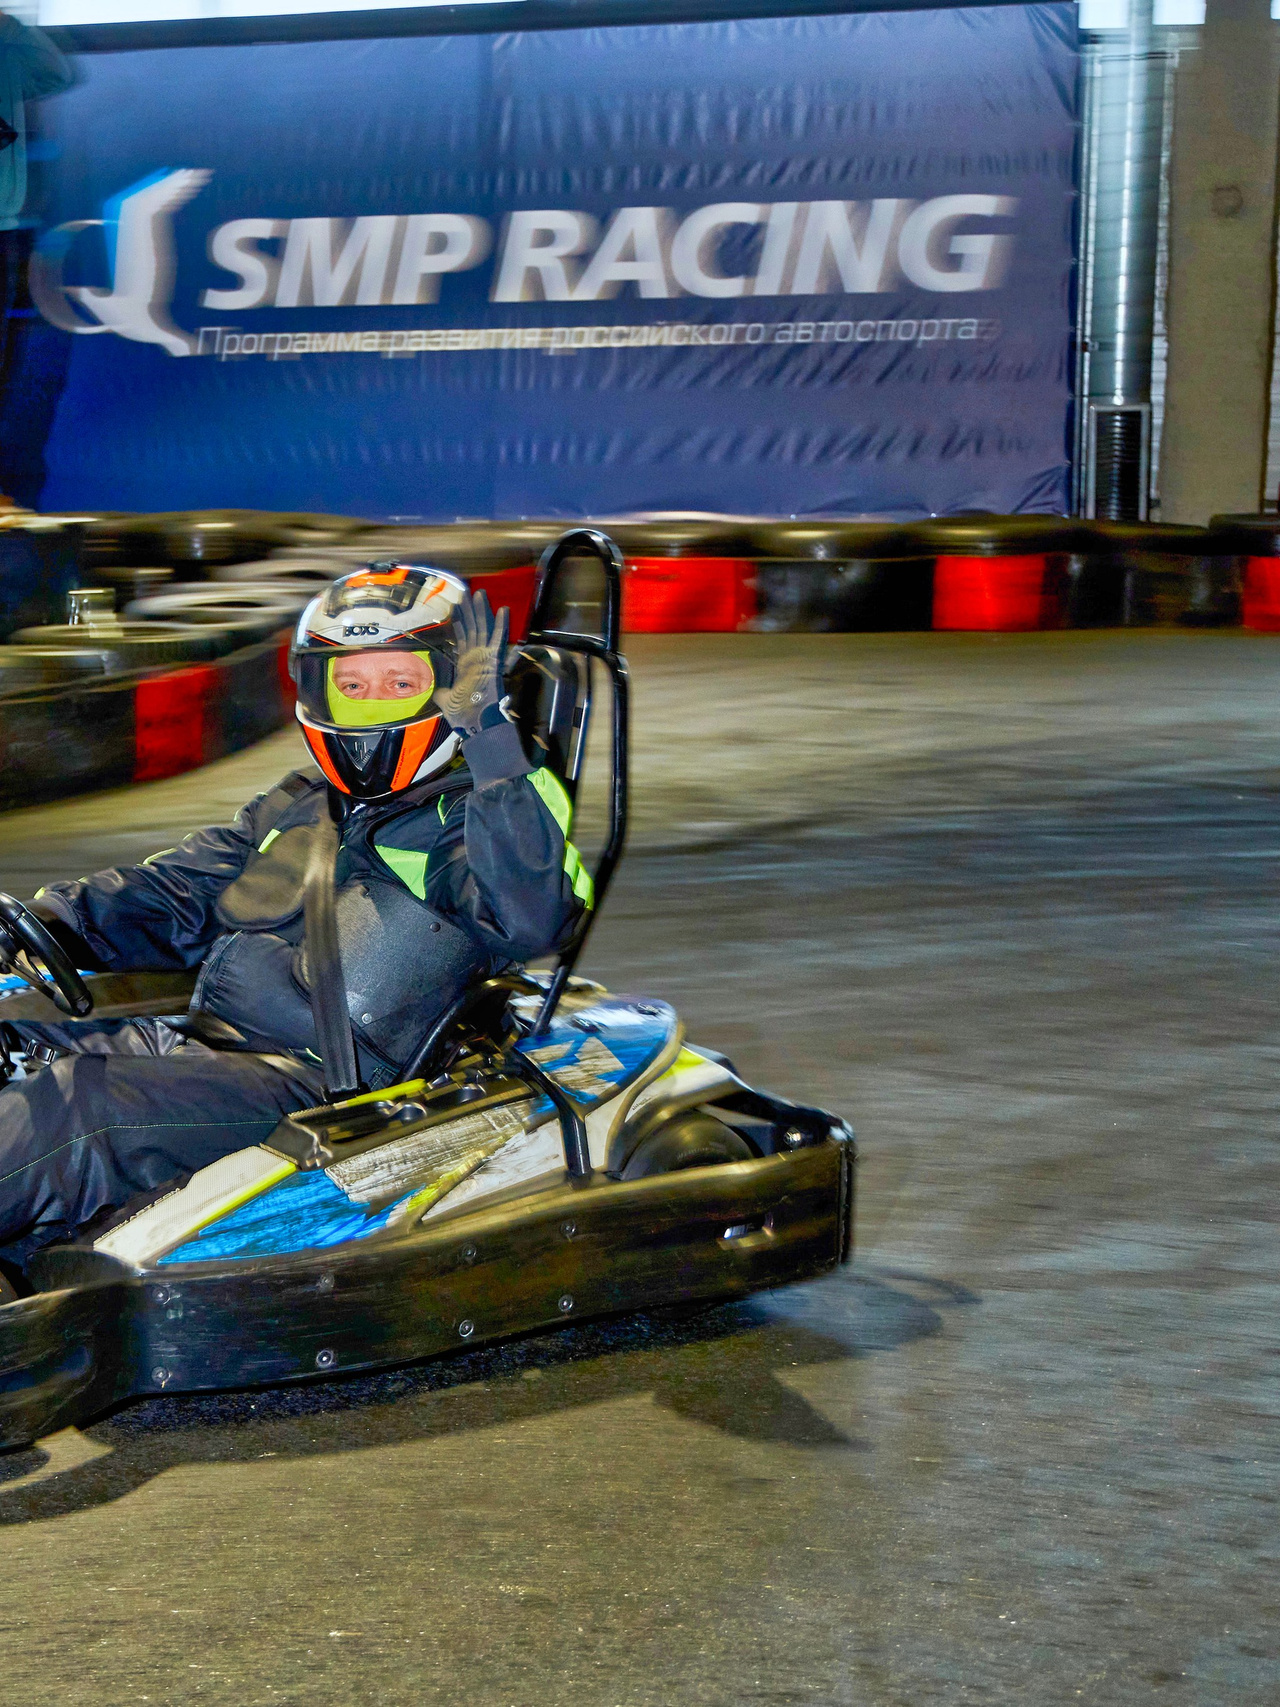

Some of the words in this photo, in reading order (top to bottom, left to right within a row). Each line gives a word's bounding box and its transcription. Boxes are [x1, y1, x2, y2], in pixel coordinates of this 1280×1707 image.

[203, 213, 478, 310] SMP
[492, 194, 1010, 302] RACING
[197, 325, 380, 362] Программа
[386, 328, 541, 359] развития
[547, 320, 766, 355] российского
[774, 318, 982, 349] автоспорта
